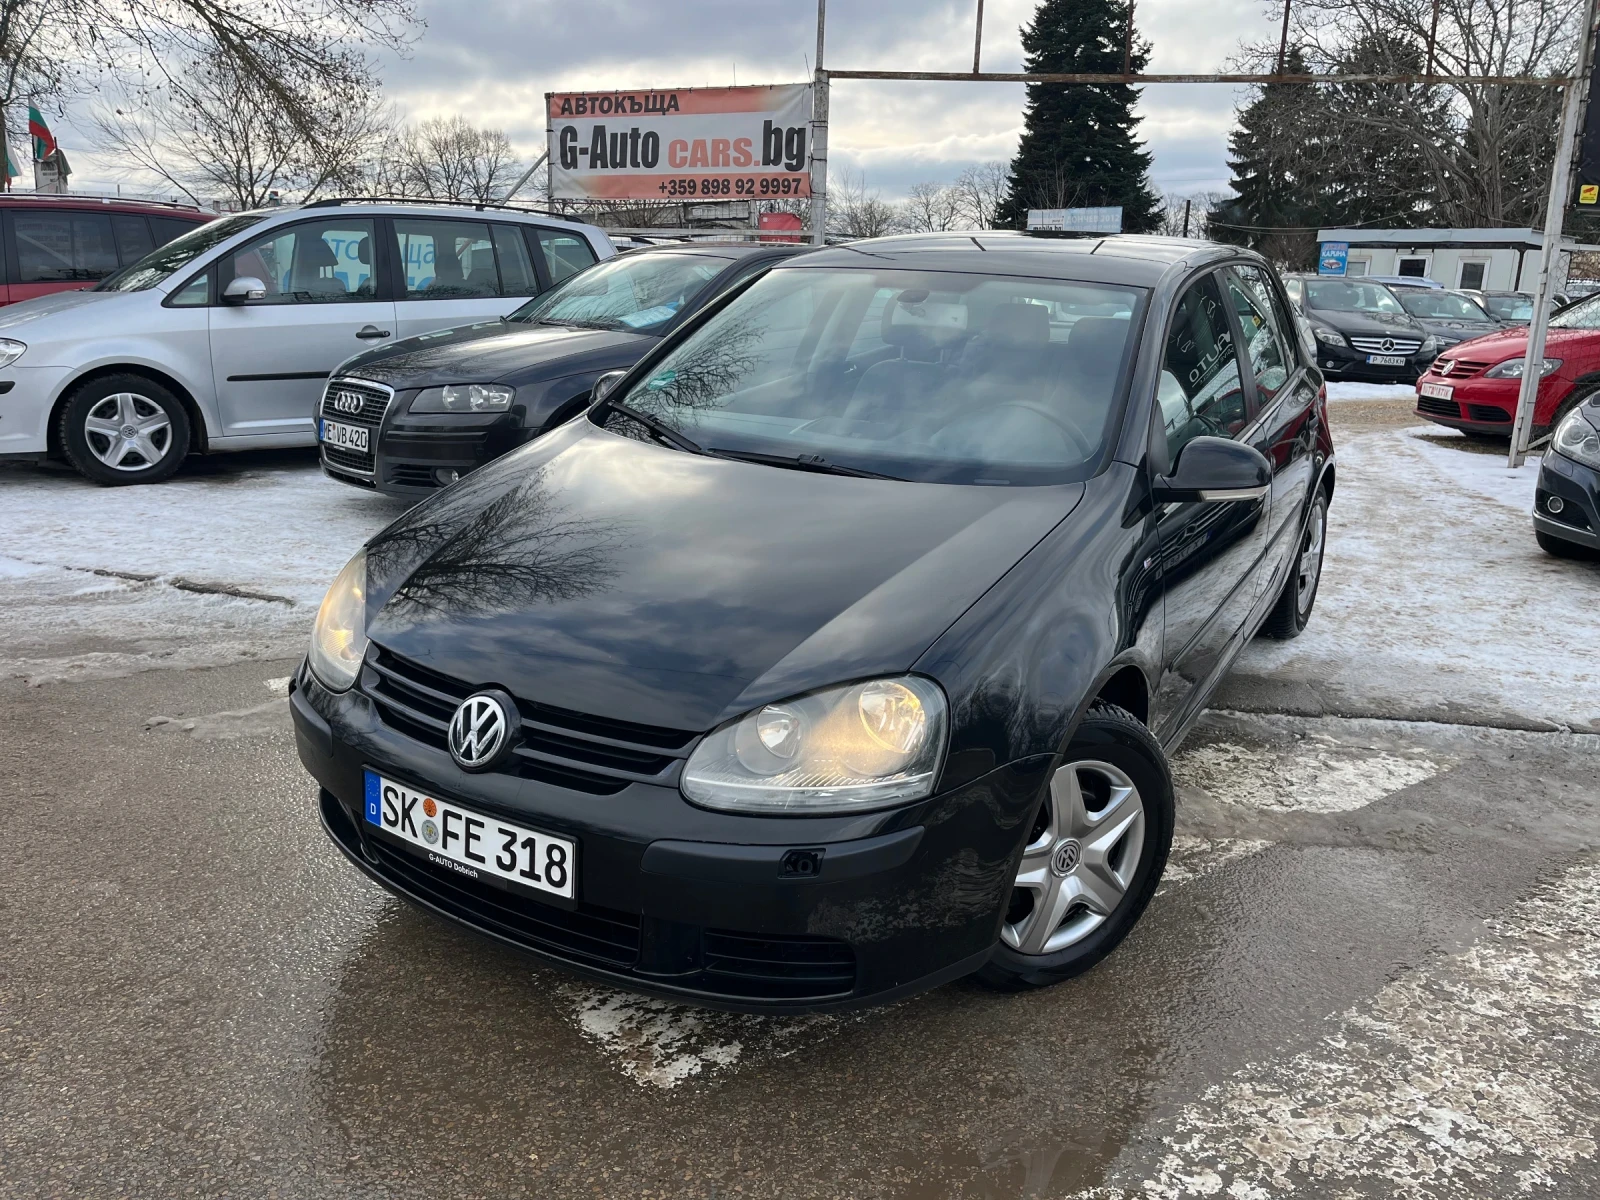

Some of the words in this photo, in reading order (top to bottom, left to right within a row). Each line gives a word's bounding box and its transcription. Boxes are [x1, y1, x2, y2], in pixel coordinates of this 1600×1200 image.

[560, 94, 680, 116] АВТОКЪЩА
[559, 125, 660, 170] G-Auto
[658, 179, 697, 195] +359
[701, 179, 731, 195] 898
[735, 178, 755, 195] 92
[759, 177, 802, 195] 9997
[349, 429, 367, 448] 420
[382, 786, 418, 838] SK
[442, 809, 486, 864] FE
[496, 827, 568, 889] 318
[428, 853, 453, 869] G-AUTO
[453, 863, 479, 879] Dobrich
